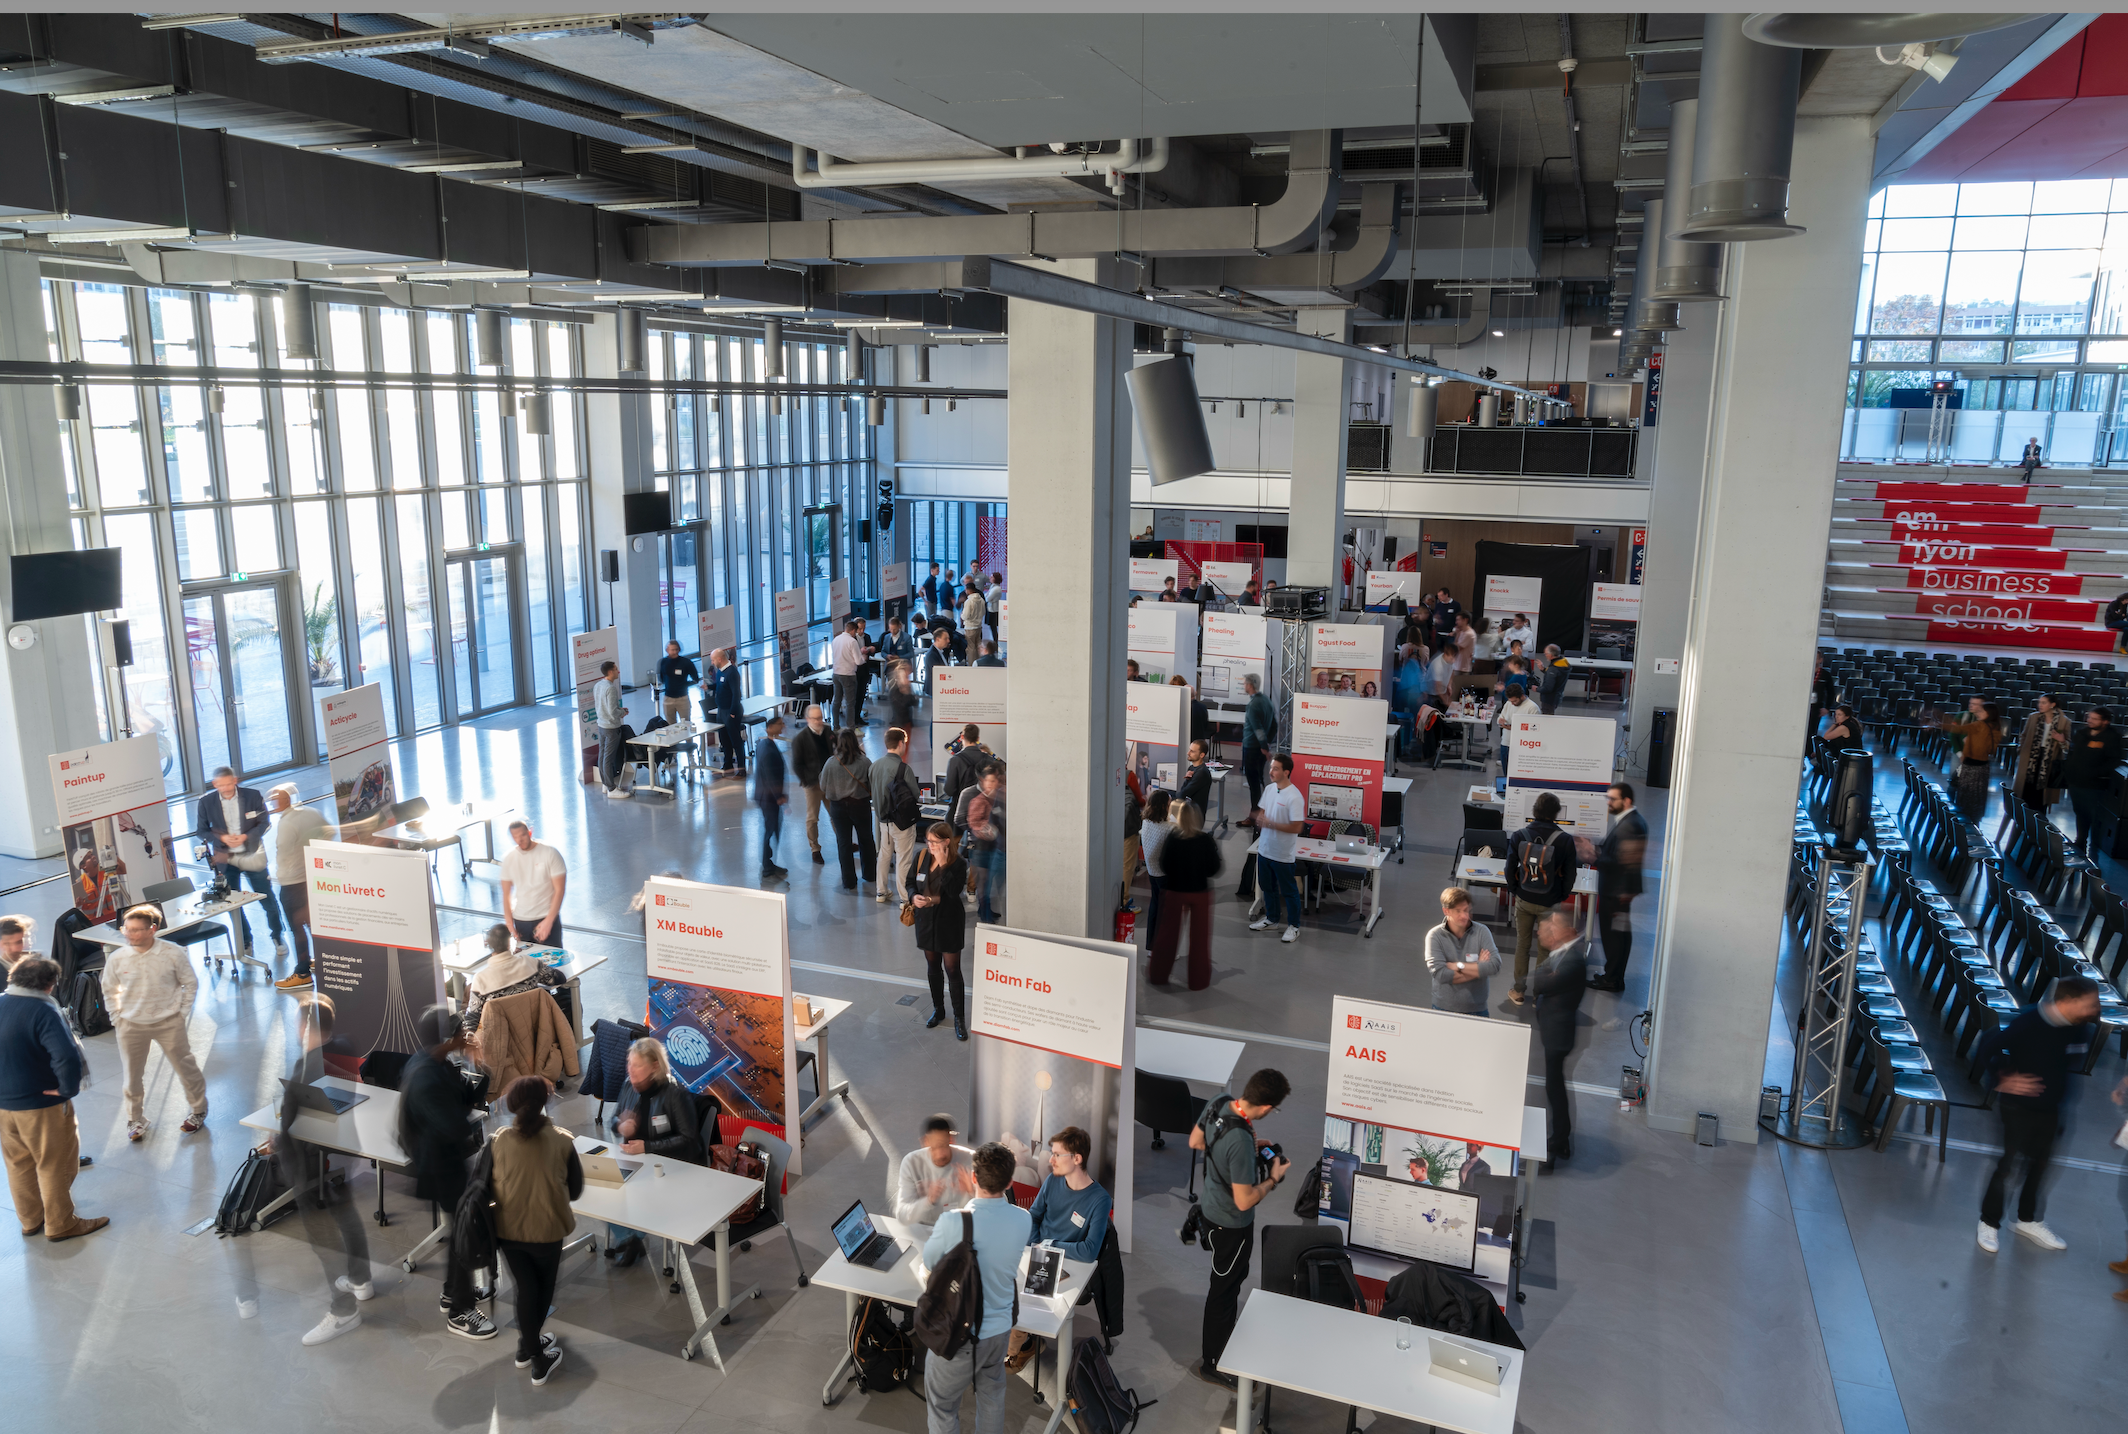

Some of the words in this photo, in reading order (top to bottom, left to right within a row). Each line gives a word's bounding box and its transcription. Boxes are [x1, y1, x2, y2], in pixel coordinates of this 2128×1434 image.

[1896, 510, 1949, 531] em
[1905, 533, 1976, 562] lyon
[1913, 562, 2050, 593] business
[1932, 600, 2049, 633] school
[1208, 627, 1234, 636] Phealing
[330, 712, 357, 726] Acticycle
[1301, 717, 1340, 728] Swapper
[64, 773, 105, 788] Paintup
[1311, 771, 1350, 780] DÉPLACEMENT
[317, 881, 341, 893] Mon
[343, 884, 375, 897] Livret
[377, 888, 385, 898] C
[656, 918, 676, 931] XM
[679, 922, 723, 938] Bauble
[986, 969, 1022, 988] Diam
[1026, 978, 1052, 994] Fab
[1345, 1045, 1387, 1063] AAIS
